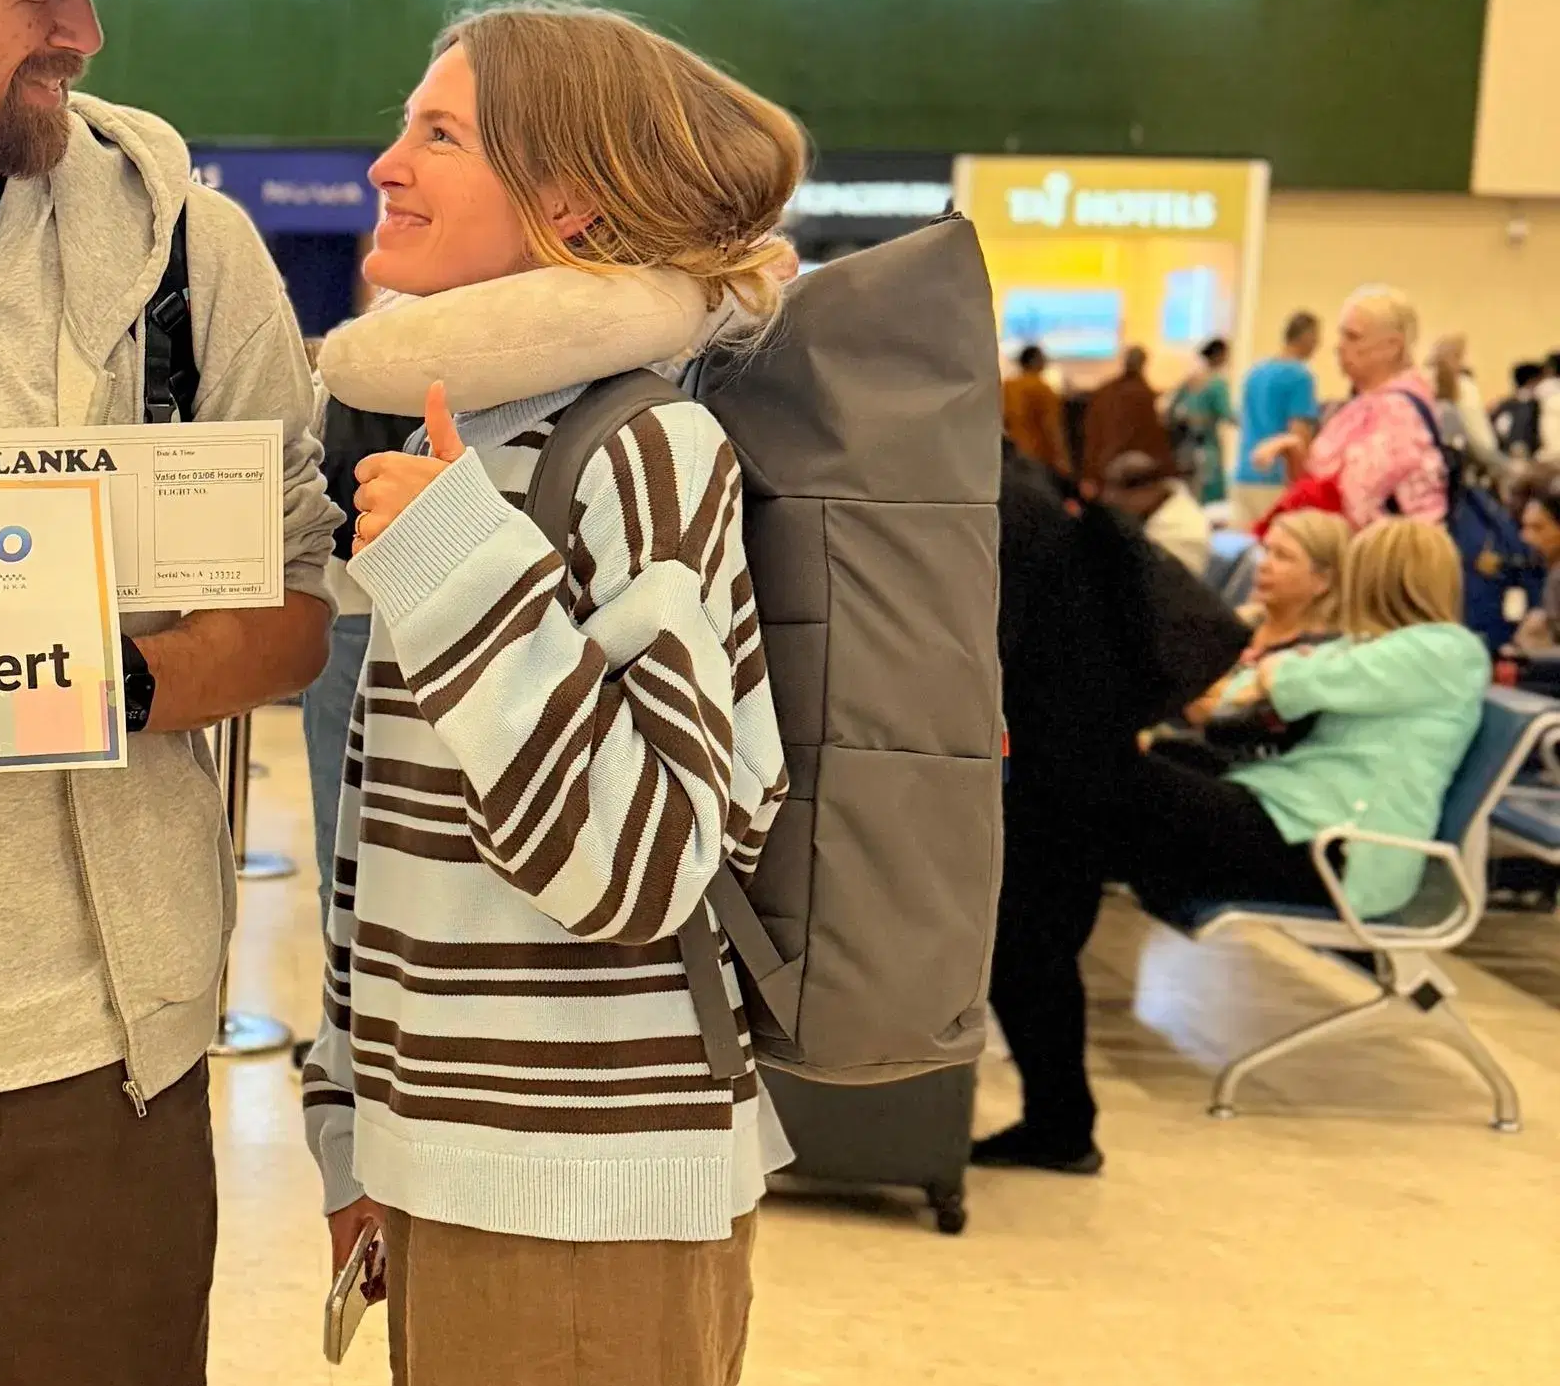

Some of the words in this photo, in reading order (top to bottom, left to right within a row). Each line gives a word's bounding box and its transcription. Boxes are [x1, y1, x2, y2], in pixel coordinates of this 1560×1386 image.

[155, 473, 176, 481] Valid
[217, 471, 243, 479] Hours
[245, 471, 263, 481] only
[158, 488, 191, 496] FLIGHT
